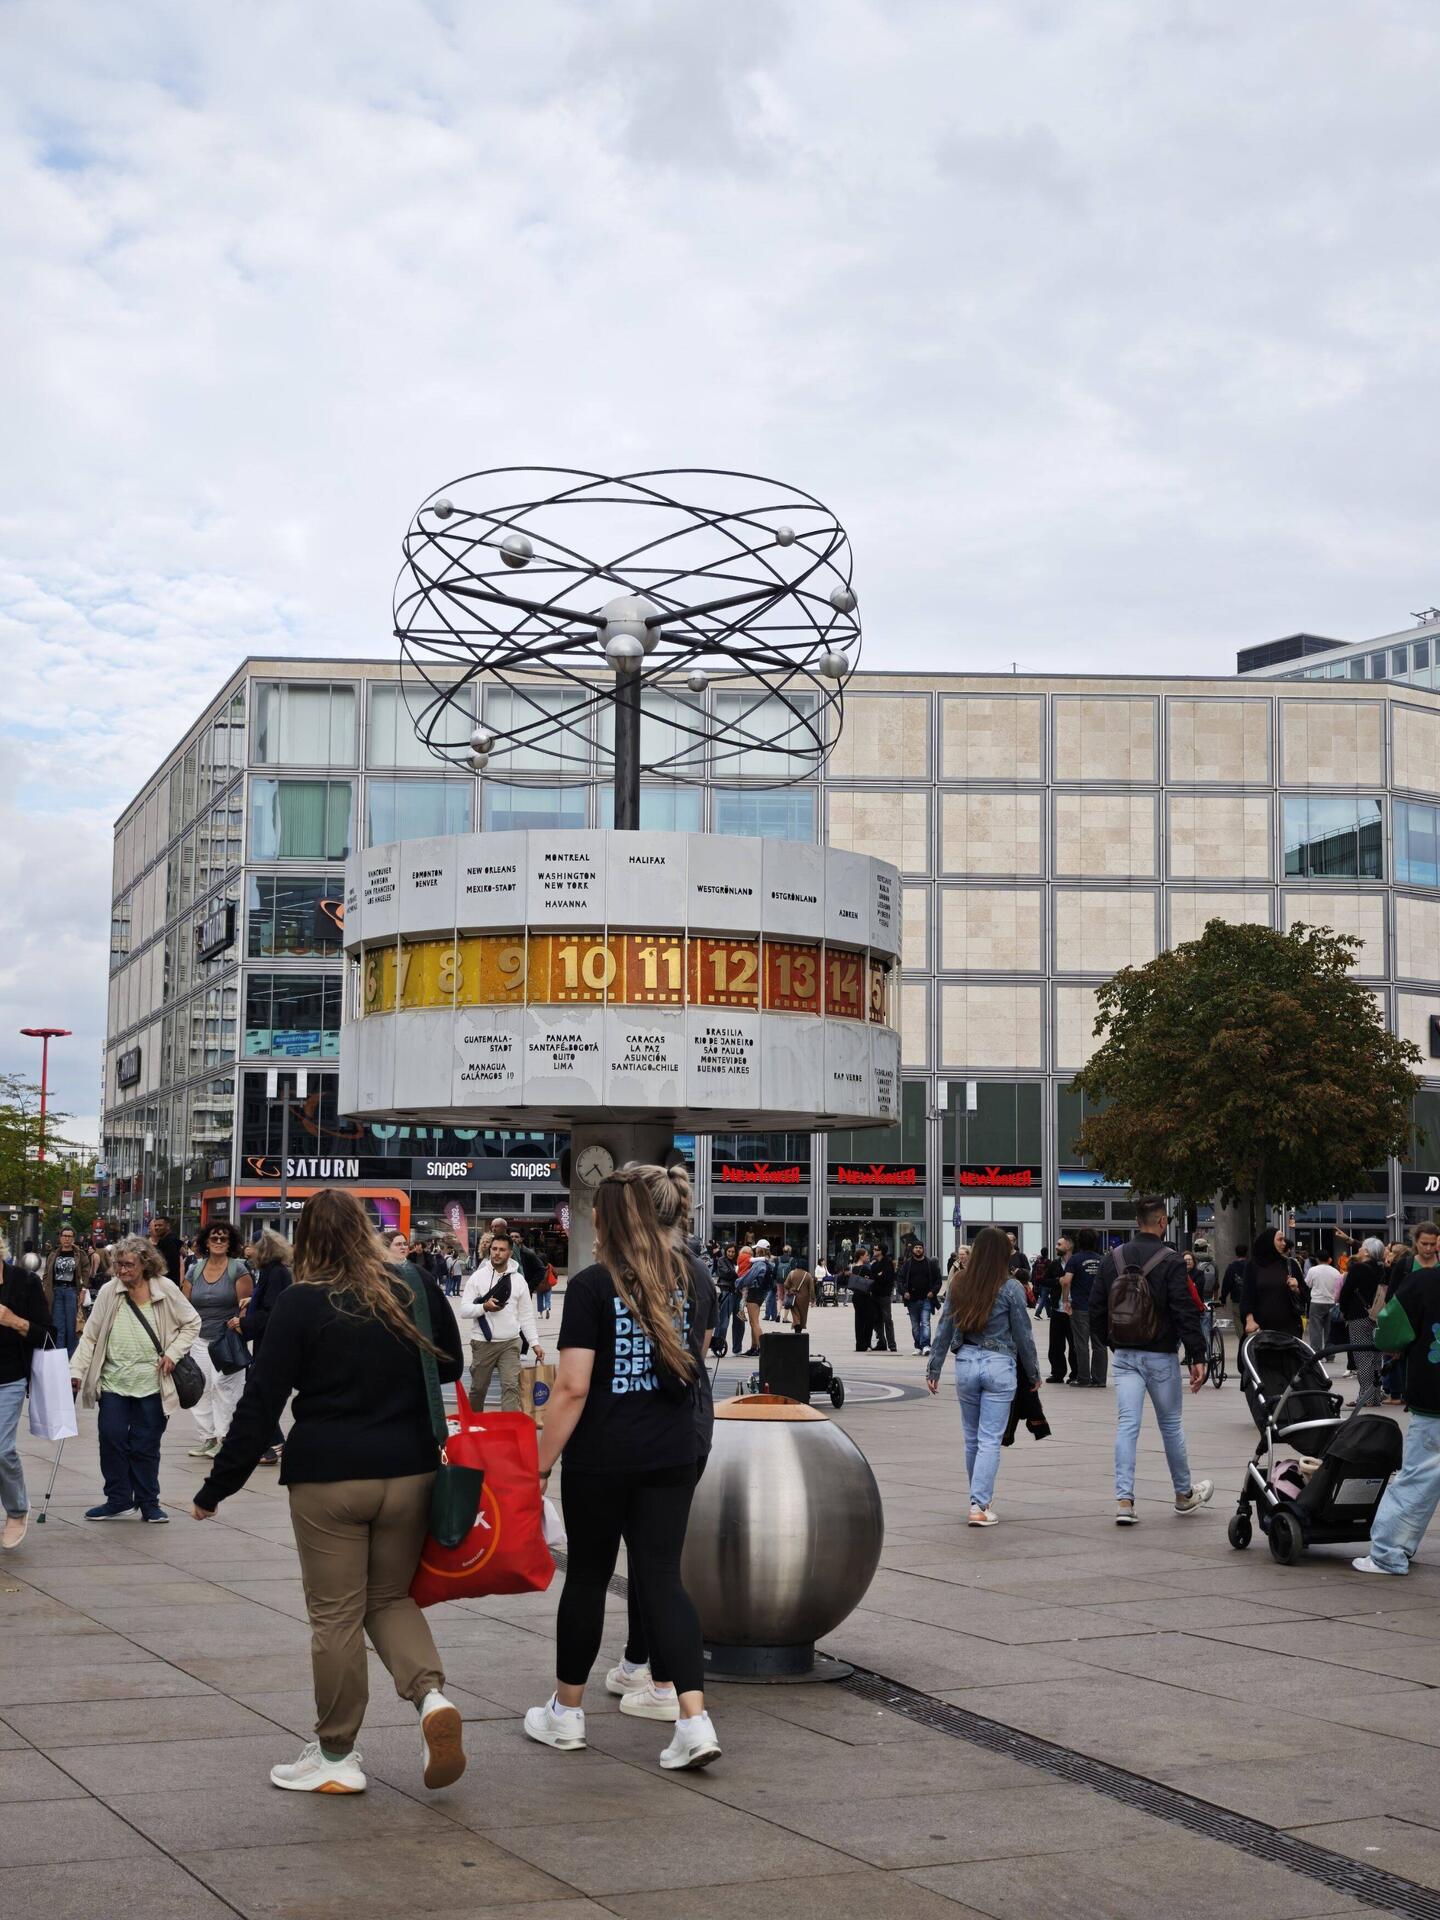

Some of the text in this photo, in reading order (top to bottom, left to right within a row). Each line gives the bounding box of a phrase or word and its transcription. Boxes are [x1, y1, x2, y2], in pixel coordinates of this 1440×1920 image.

[545, 853, 590, 862] MONTREAL
[629, 856, 666, 865] HALIFAX
[412, 869, 443, 880] EDMONTON
[466, 865, 517, 875] NEW ORLEANS
[538, 871, 596, 880] WASHINGTON
[415, 878, 438, 888] DENVER
[544, 881, 589, 890] NEW YORK
[466, 883, 516, 894] MEXIKO-STADT
[697, 884, 753, 896] WESTGRÖNLAND
[771, 891, 817, 904] OSTGRÖNLAND
[545, 900, 588, 909] HAVANNA
[438, 950, 463, 993] 8
[497, 946, 531, 991] 9
[558, 945, 617, 990] 10
[638, 947, 681, 990] 11
[709, 949, 758, 992] 12
[392, 953, 412, 996] 7
[776, 954, 816, 998] 13
[366, 960, 377, 1002] 6
[829, 960, 857, 1003] 14
[706, 1028, 743, 1037] BRASILIA
[463, 1035, 513, 1044] GUATEMALA-
[546, 1034, 582, 1042] PANAMA
[626, 1035, 665, 1044] CARACAS
[694, 1036, 754, 1047] RIO DE JANEIRO
[490, 1044, 513, 1052] STADT
[630, 1044, 660, 1053] LA PAZ
[703, 1045, 745, 1055] SÃO PAULO
[552, 1053, 576, 1061] QUITO
[624, 1052, 667, 1062] ASUNCIÓN
[700, 1056, 747, 1065] MONTEVIDEO
[468, 1063, 507, 1071] MANAGUA
[553, 1062, 574, 1070] LIMA
[697, 1065, 750, 1075] BUENOS AIRES
[460, 1070, 502, 1081] GALÁPAGOS
[286, 1158, 360, 1178] SATURN
[1425, 1176, 1440, 1192] JD
